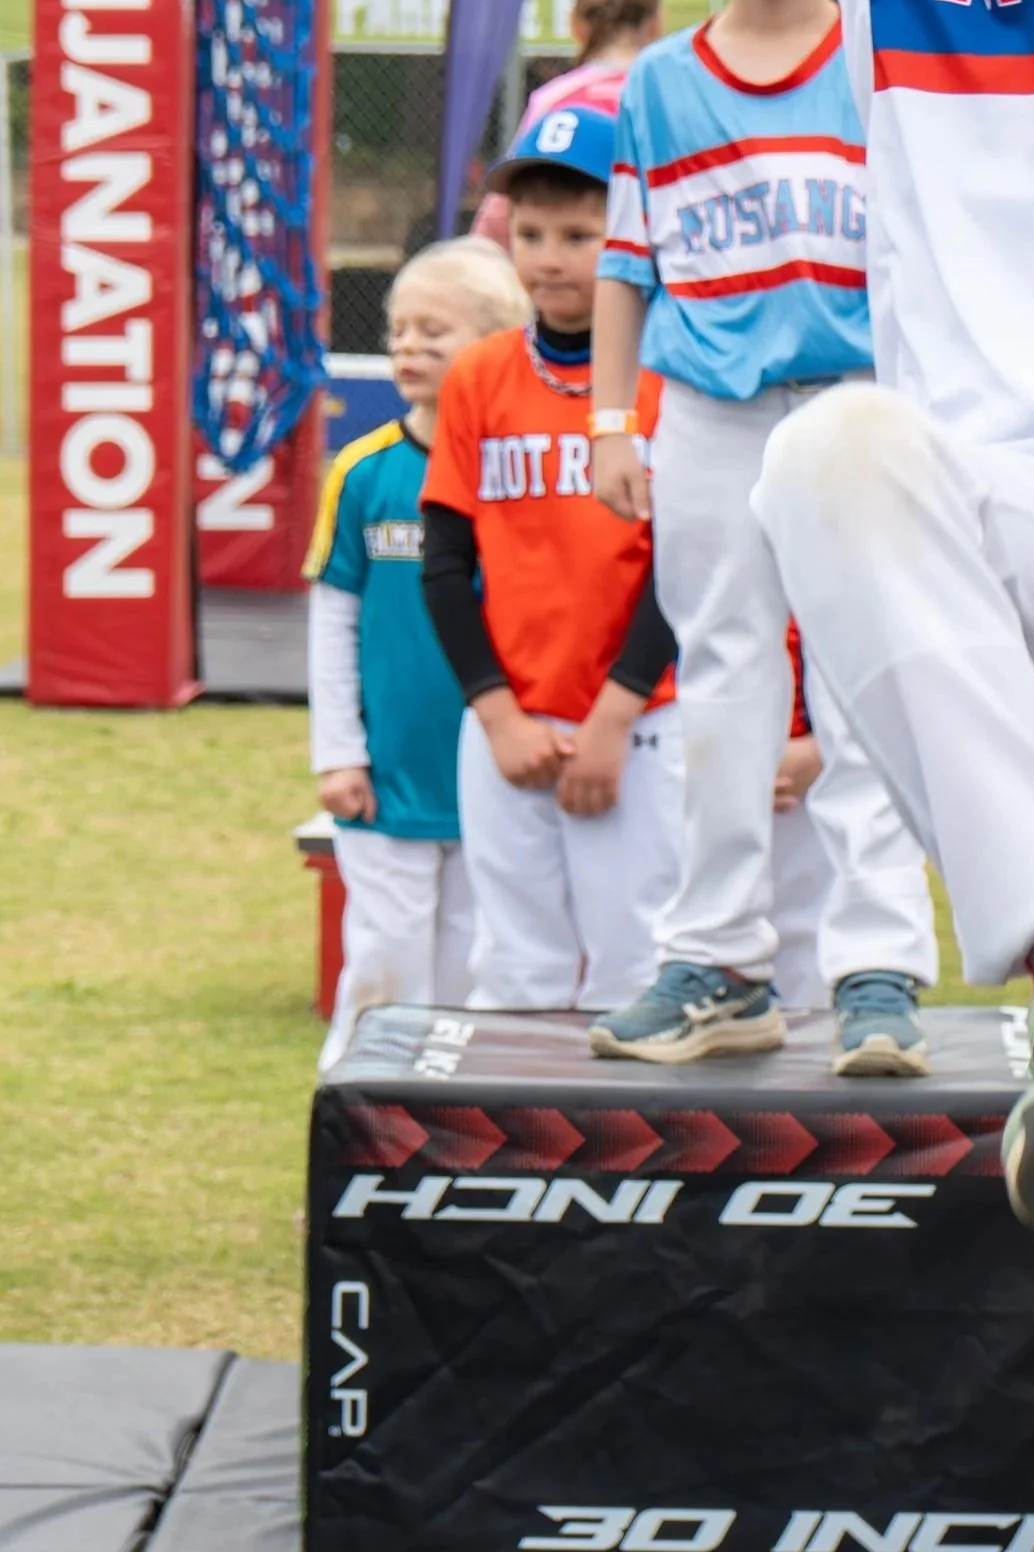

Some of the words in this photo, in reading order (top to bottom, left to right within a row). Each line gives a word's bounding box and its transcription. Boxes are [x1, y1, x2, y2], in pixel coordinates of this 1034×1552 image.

[535, 110, 580, 154] G
[478, 434, 552, 501] HOT
[332, 1173, 684, 1225] INCH
[718, 1181, 937, 1228] 30
[330, 1280, 371, 1438] CAP
[517, 1505, 738, 1552] 30
